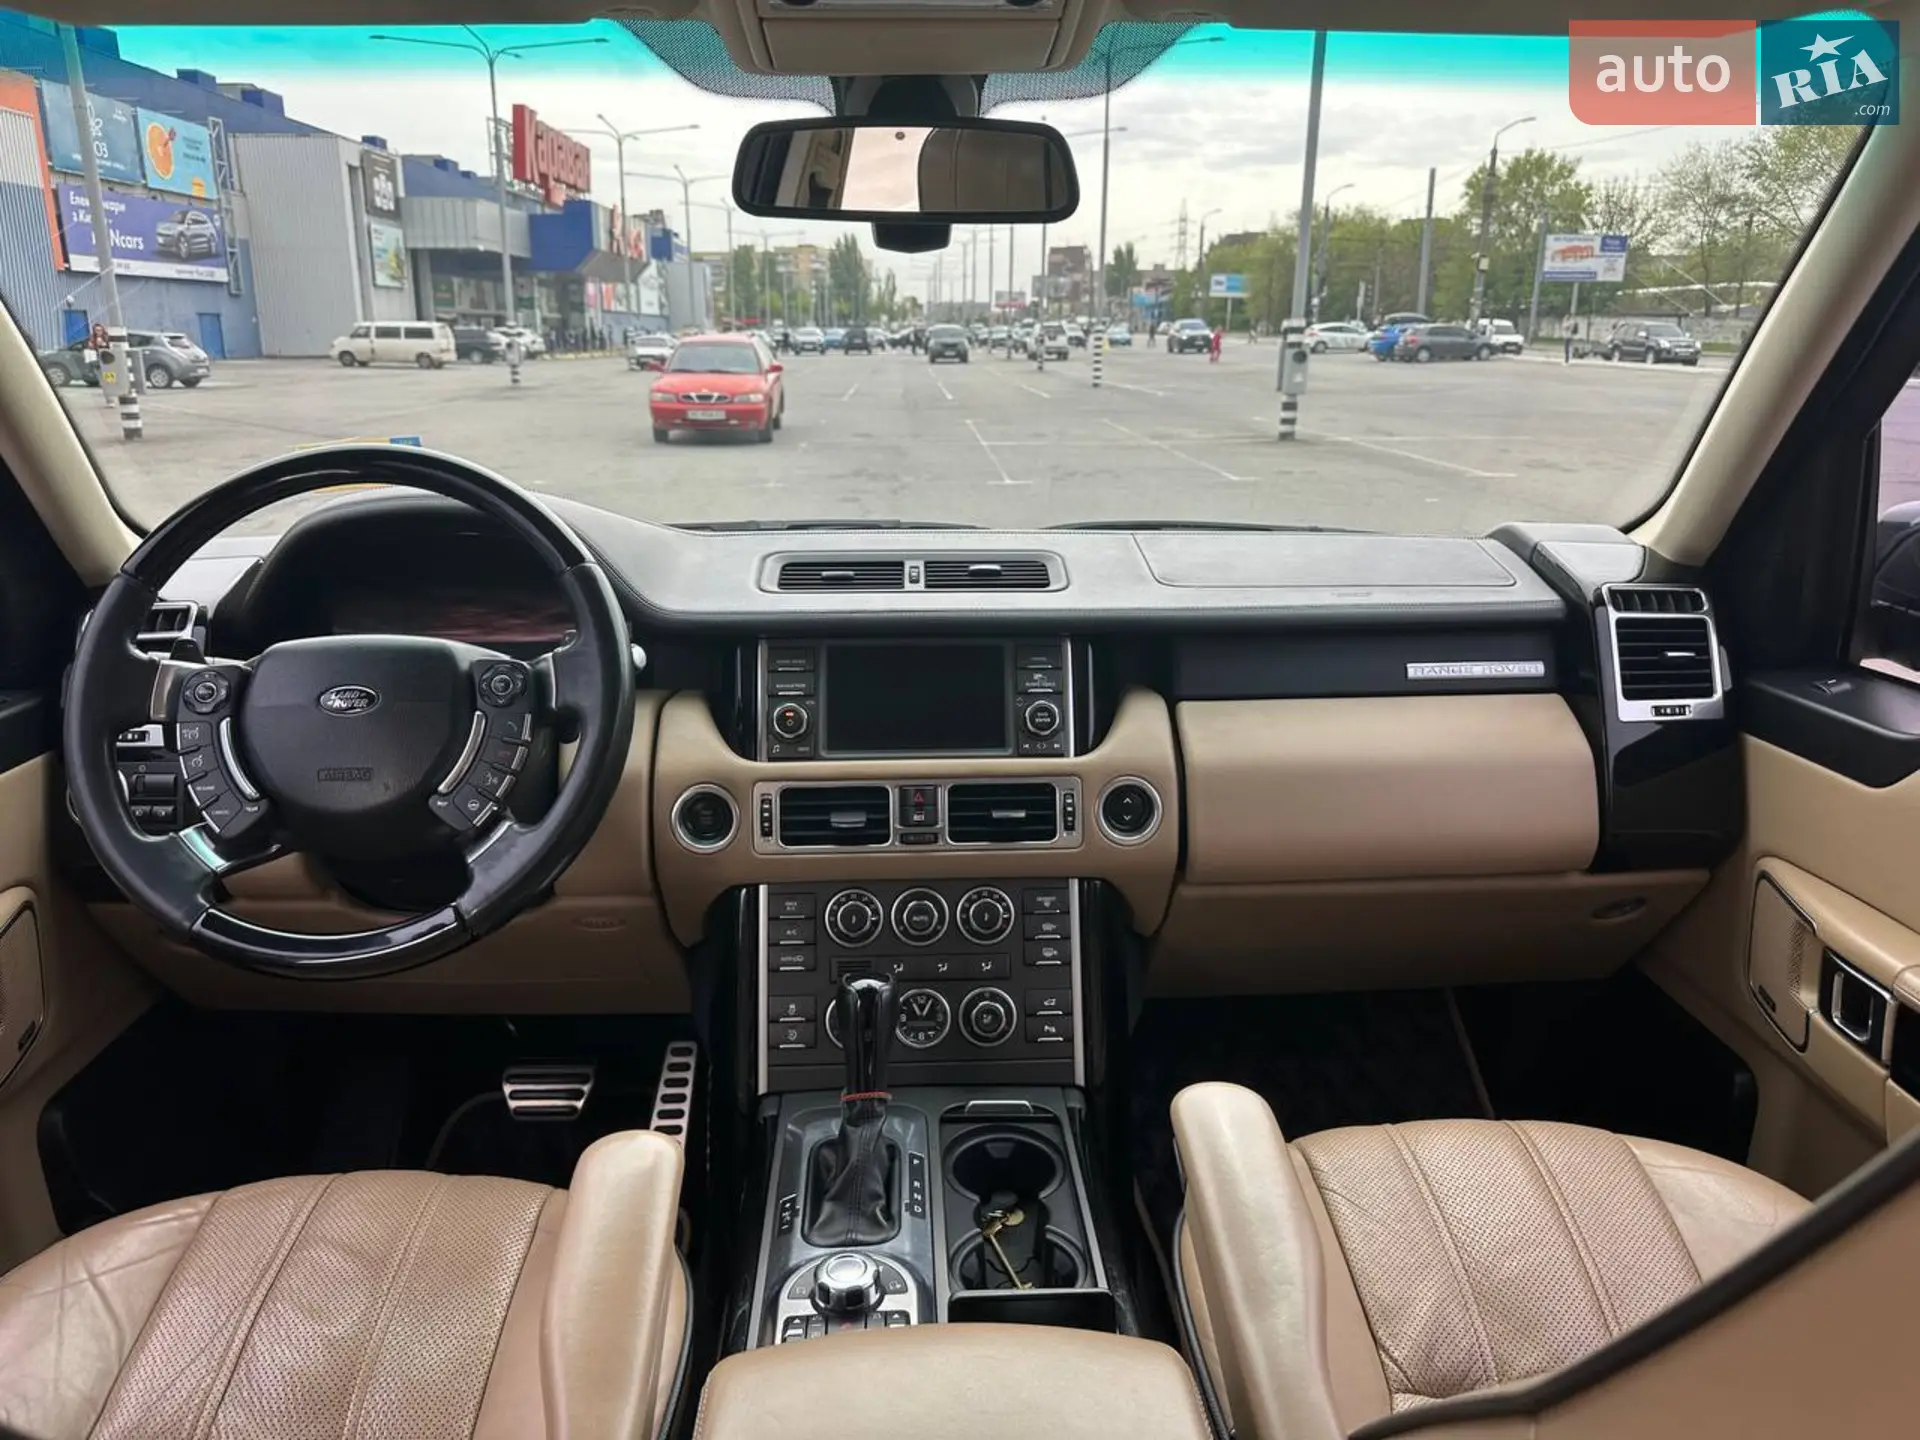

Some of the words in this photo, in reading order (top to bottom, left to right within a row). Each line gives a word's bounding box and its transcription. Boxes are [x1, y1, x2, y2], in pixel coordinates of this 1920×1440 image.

[513, 104, 591, 208] Караван
[1411, 664, 1475, 677] RANGE
[1482, 662, 1541, 675] ROVER
[330, 690, 361, 700] LAND
[333, 699, 369, 709] ROVER
